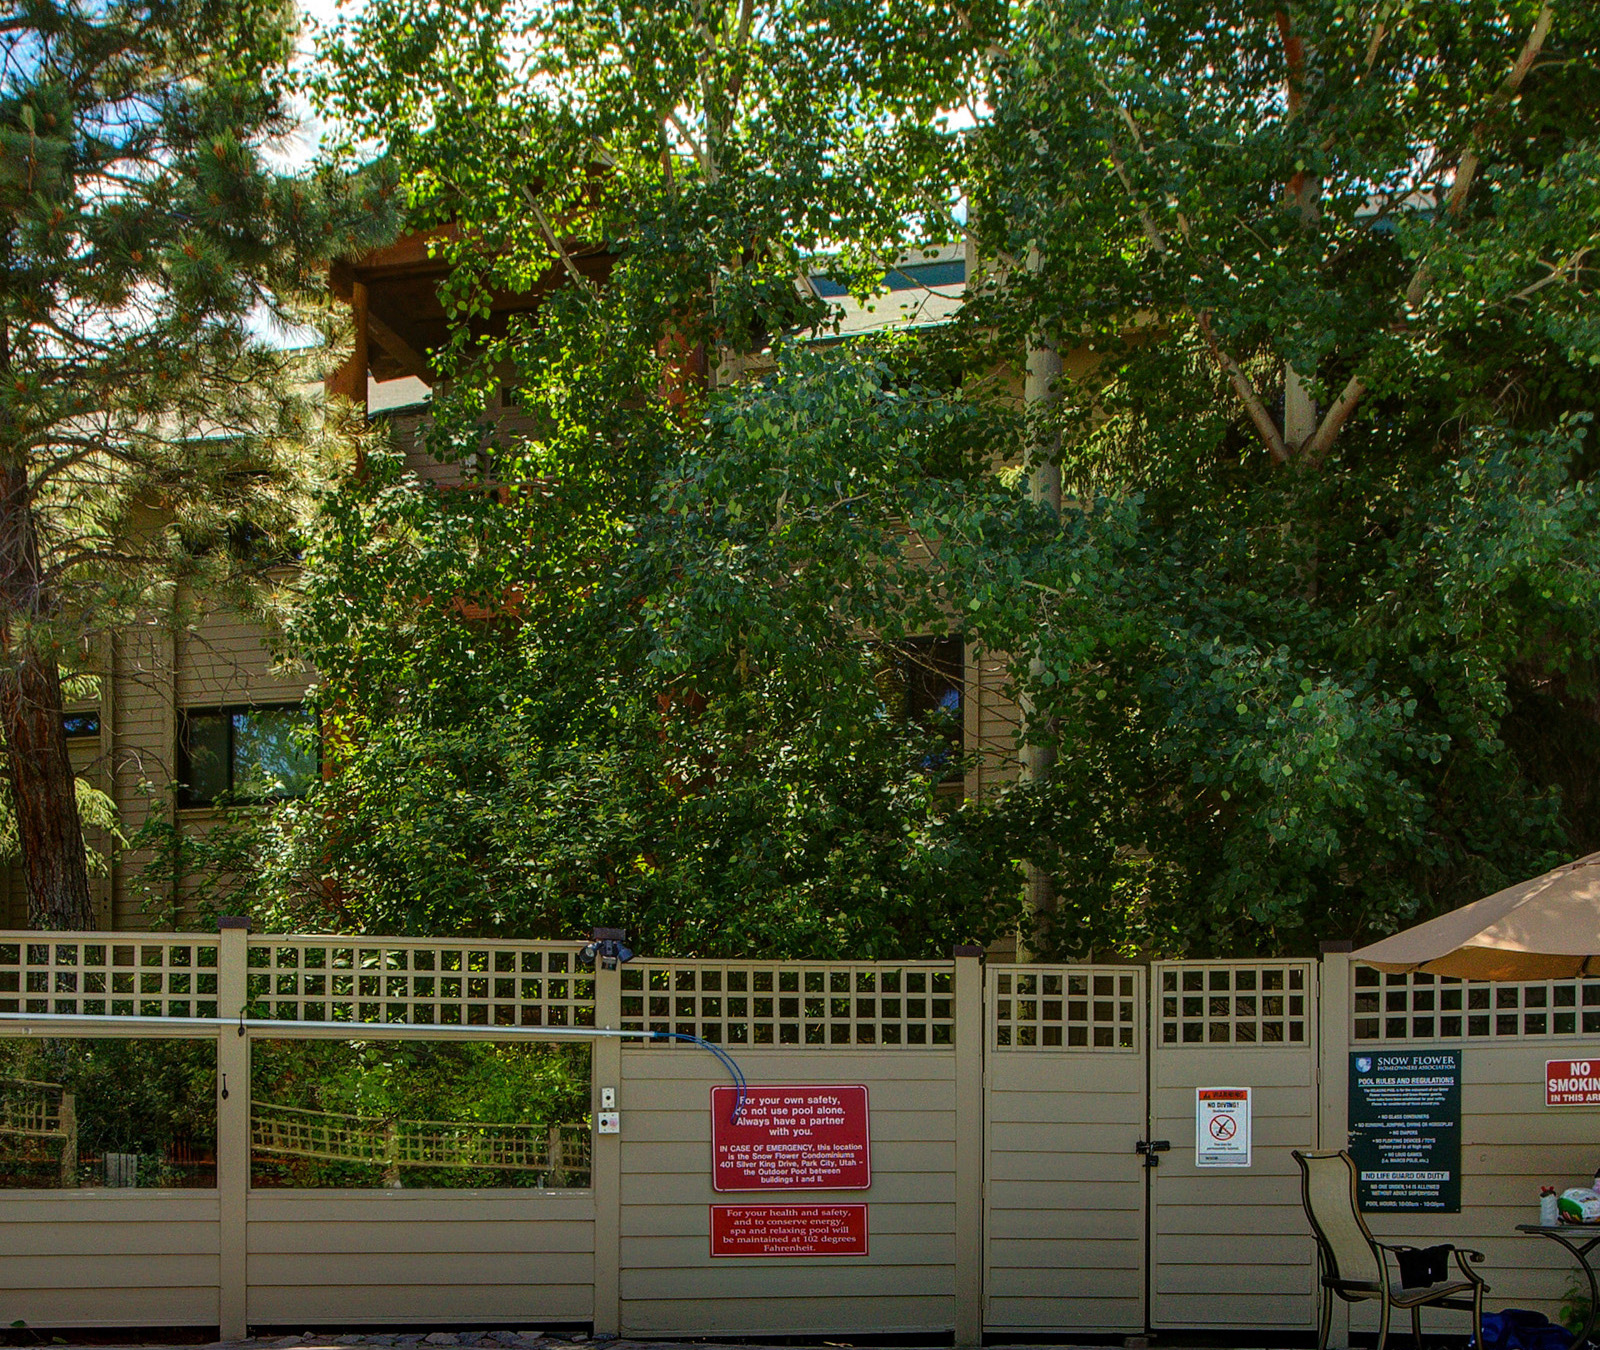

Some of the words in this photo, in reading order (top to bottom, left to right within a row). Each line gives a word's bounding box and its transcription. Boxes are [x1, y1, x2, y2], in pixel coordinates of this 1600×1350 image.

[1378, 1057, 1409, 1065] SNOW
[1413, 1056, 1454, 1065] FLOWER
[1571, 1062, 1590, 1076] NO
[739, 1096, 755, 1104] For
[759, 1097, 780, 1105] your
[808, 1096, 840, 1104] safety,
[1563, 1094, 1583, 1102] THIS
[792, 1107, 813, 1116] pool
[736, 1118, 769, 1126] Always
[774, 1117, 796, 1125] have
[810, 1118, 844, 1126] partner
[769, 1128, 789, 1136] with
[793, 1129, 813, 1137] you.
[745, 1211, 767, 1219] your
[822, 1209, 851, 1217] safety,
[730, 1228, 746, 1236] spa
[770, 1227, 806, 1235] relaxing
[809, 1227, 829, 1235] pool
[821, 1235, 856, 1244] degrees
